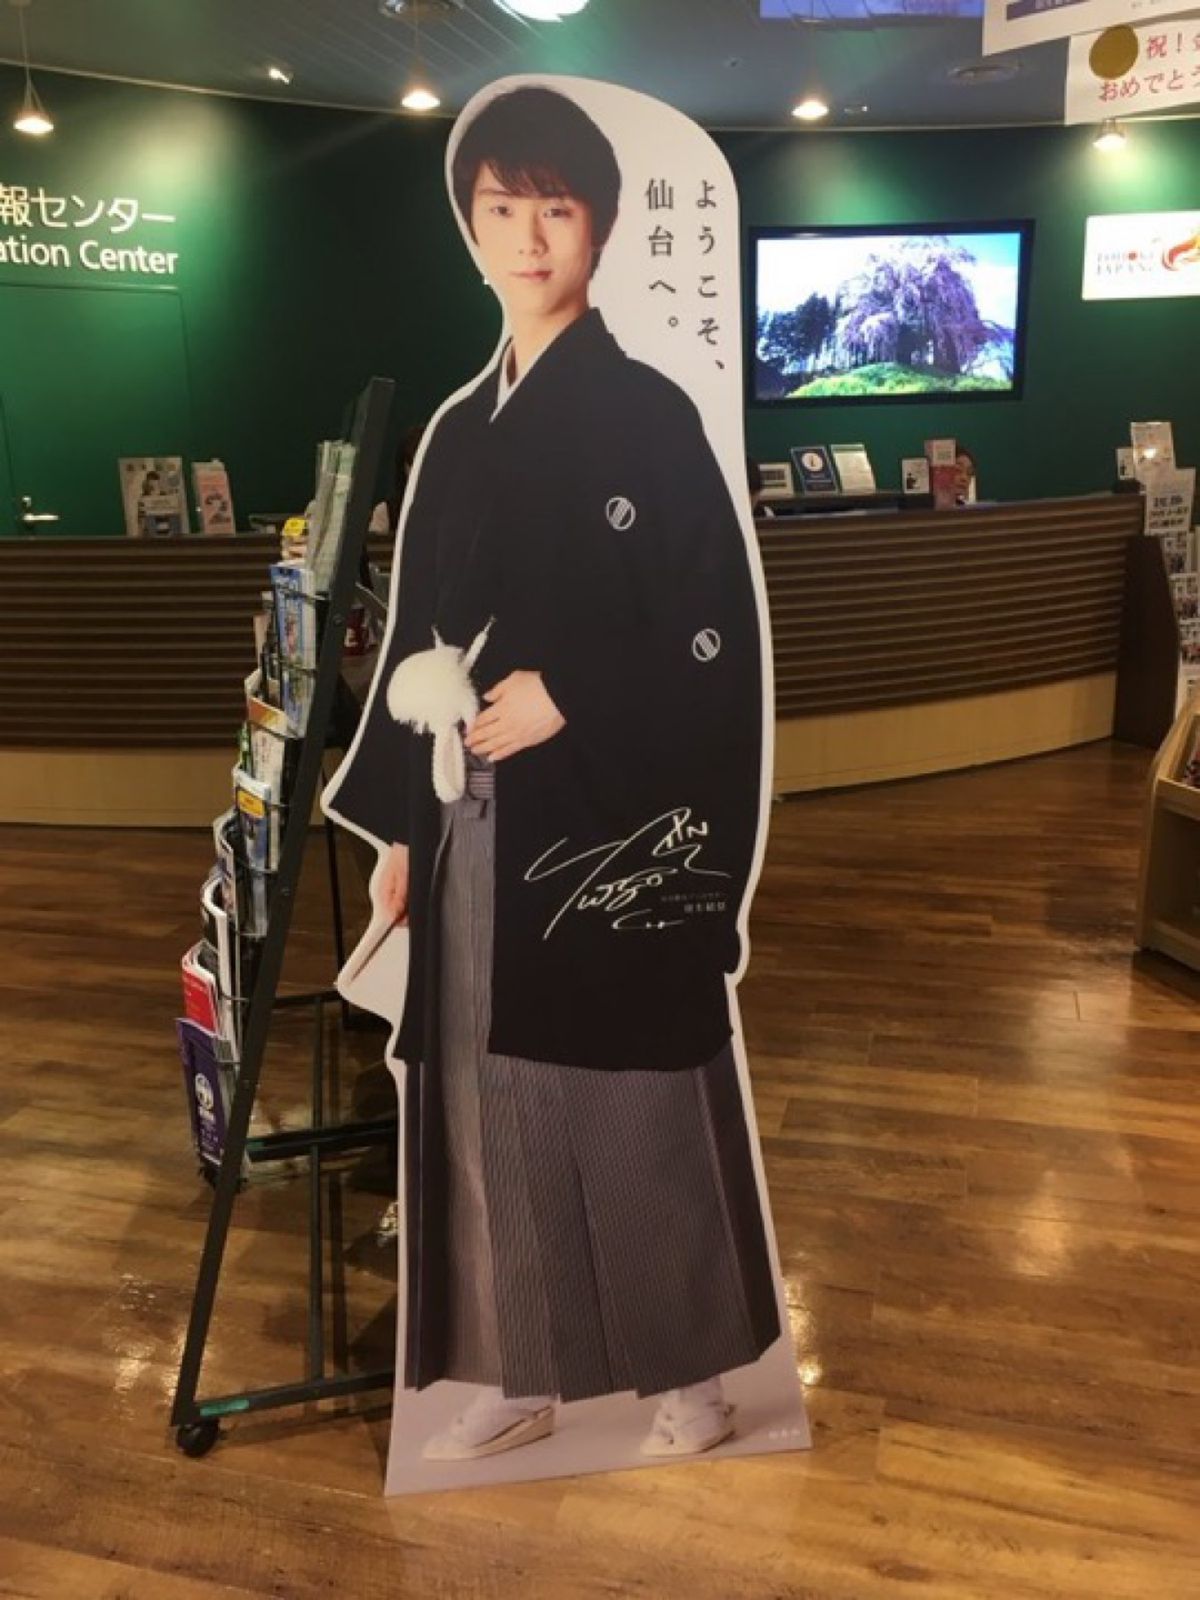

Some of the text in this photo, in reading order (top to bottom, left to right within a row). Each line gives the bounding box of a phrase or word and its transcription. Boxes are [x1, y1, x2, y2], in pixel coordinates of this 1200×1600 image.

[79, 240, 179, 275] Center
[644, 178, 679, 328] 仙台へ。
[696, 179, 725, 370] ようこそ、
